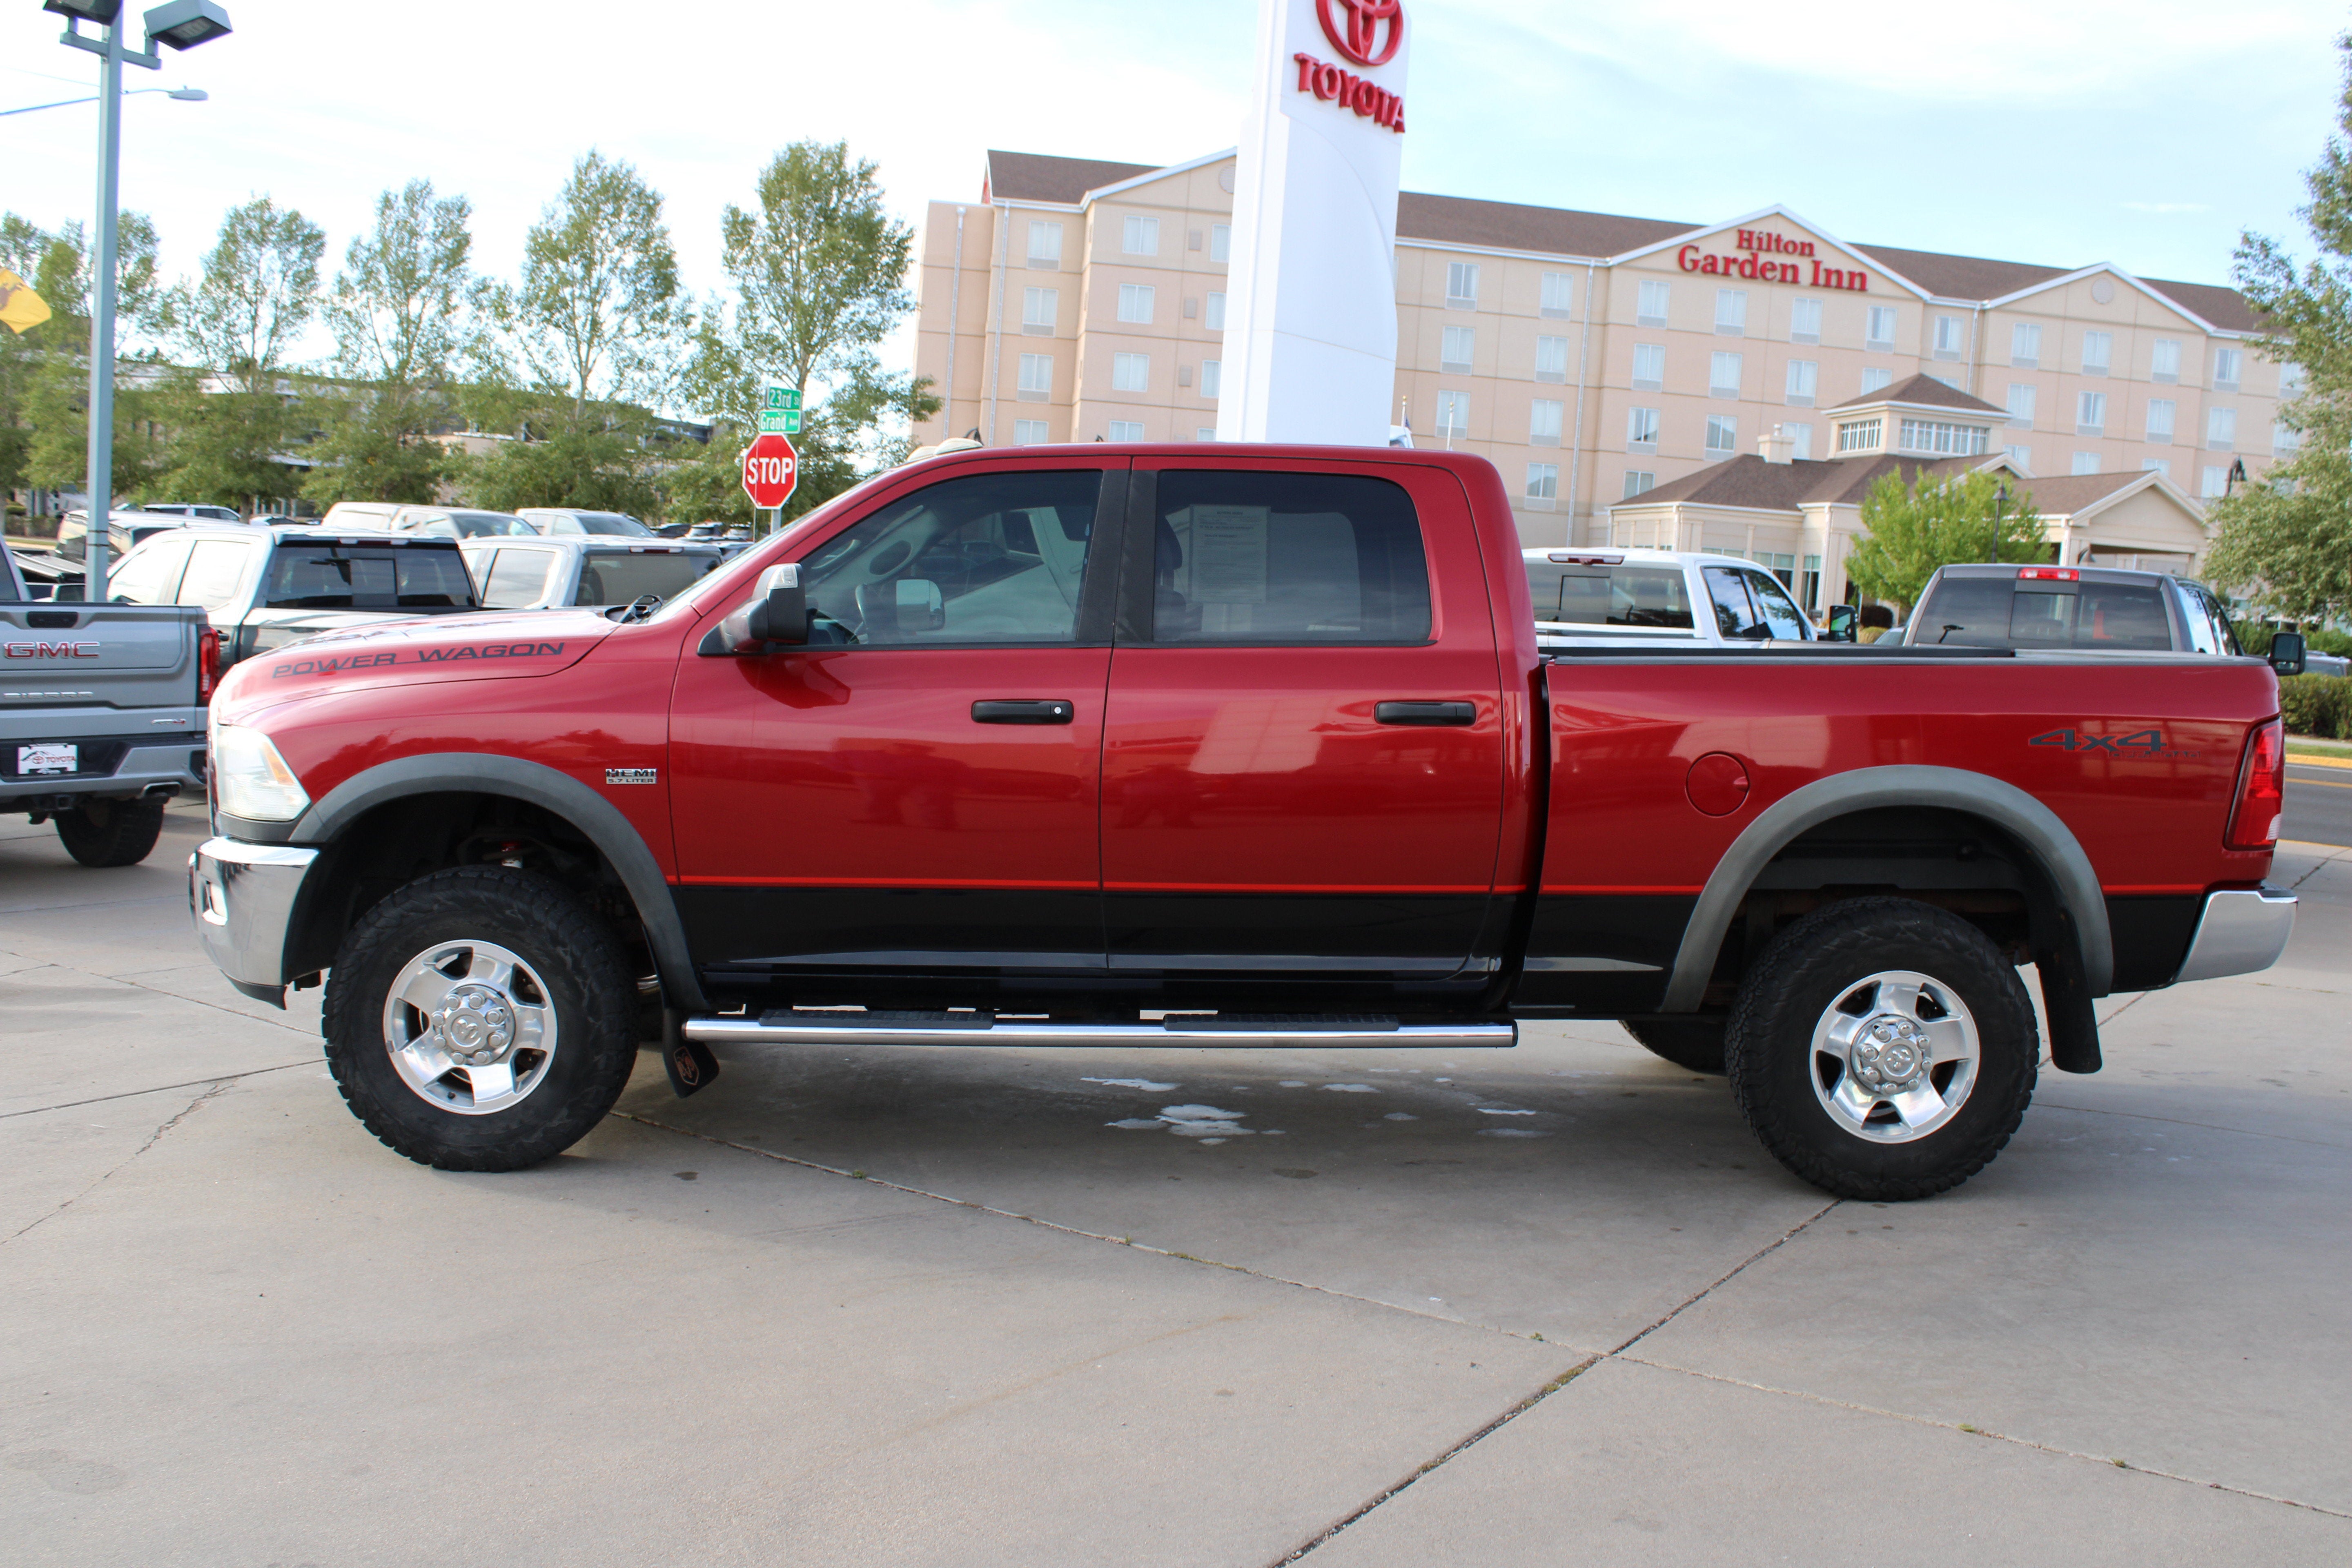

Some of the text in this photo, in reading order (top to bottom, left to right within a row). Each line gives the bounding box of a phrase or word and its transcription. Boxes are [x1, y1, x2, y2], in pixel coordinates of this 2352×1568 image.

[1294, 52, 1405, 133] TOYOTA
[1737, 229, 1815, 256] Hilton
[1678, 244, 1868, 291] Garden Inn
[769, 389, 792, 408] 23rd
[761, 413, 787, 430] Grand
[747, 457, 793, 485] STOP
[3, 641, 100, 659] GMC
[272, 642, 566, 679] POWER WAGON
[606, 768, 657, 777] HEMI
